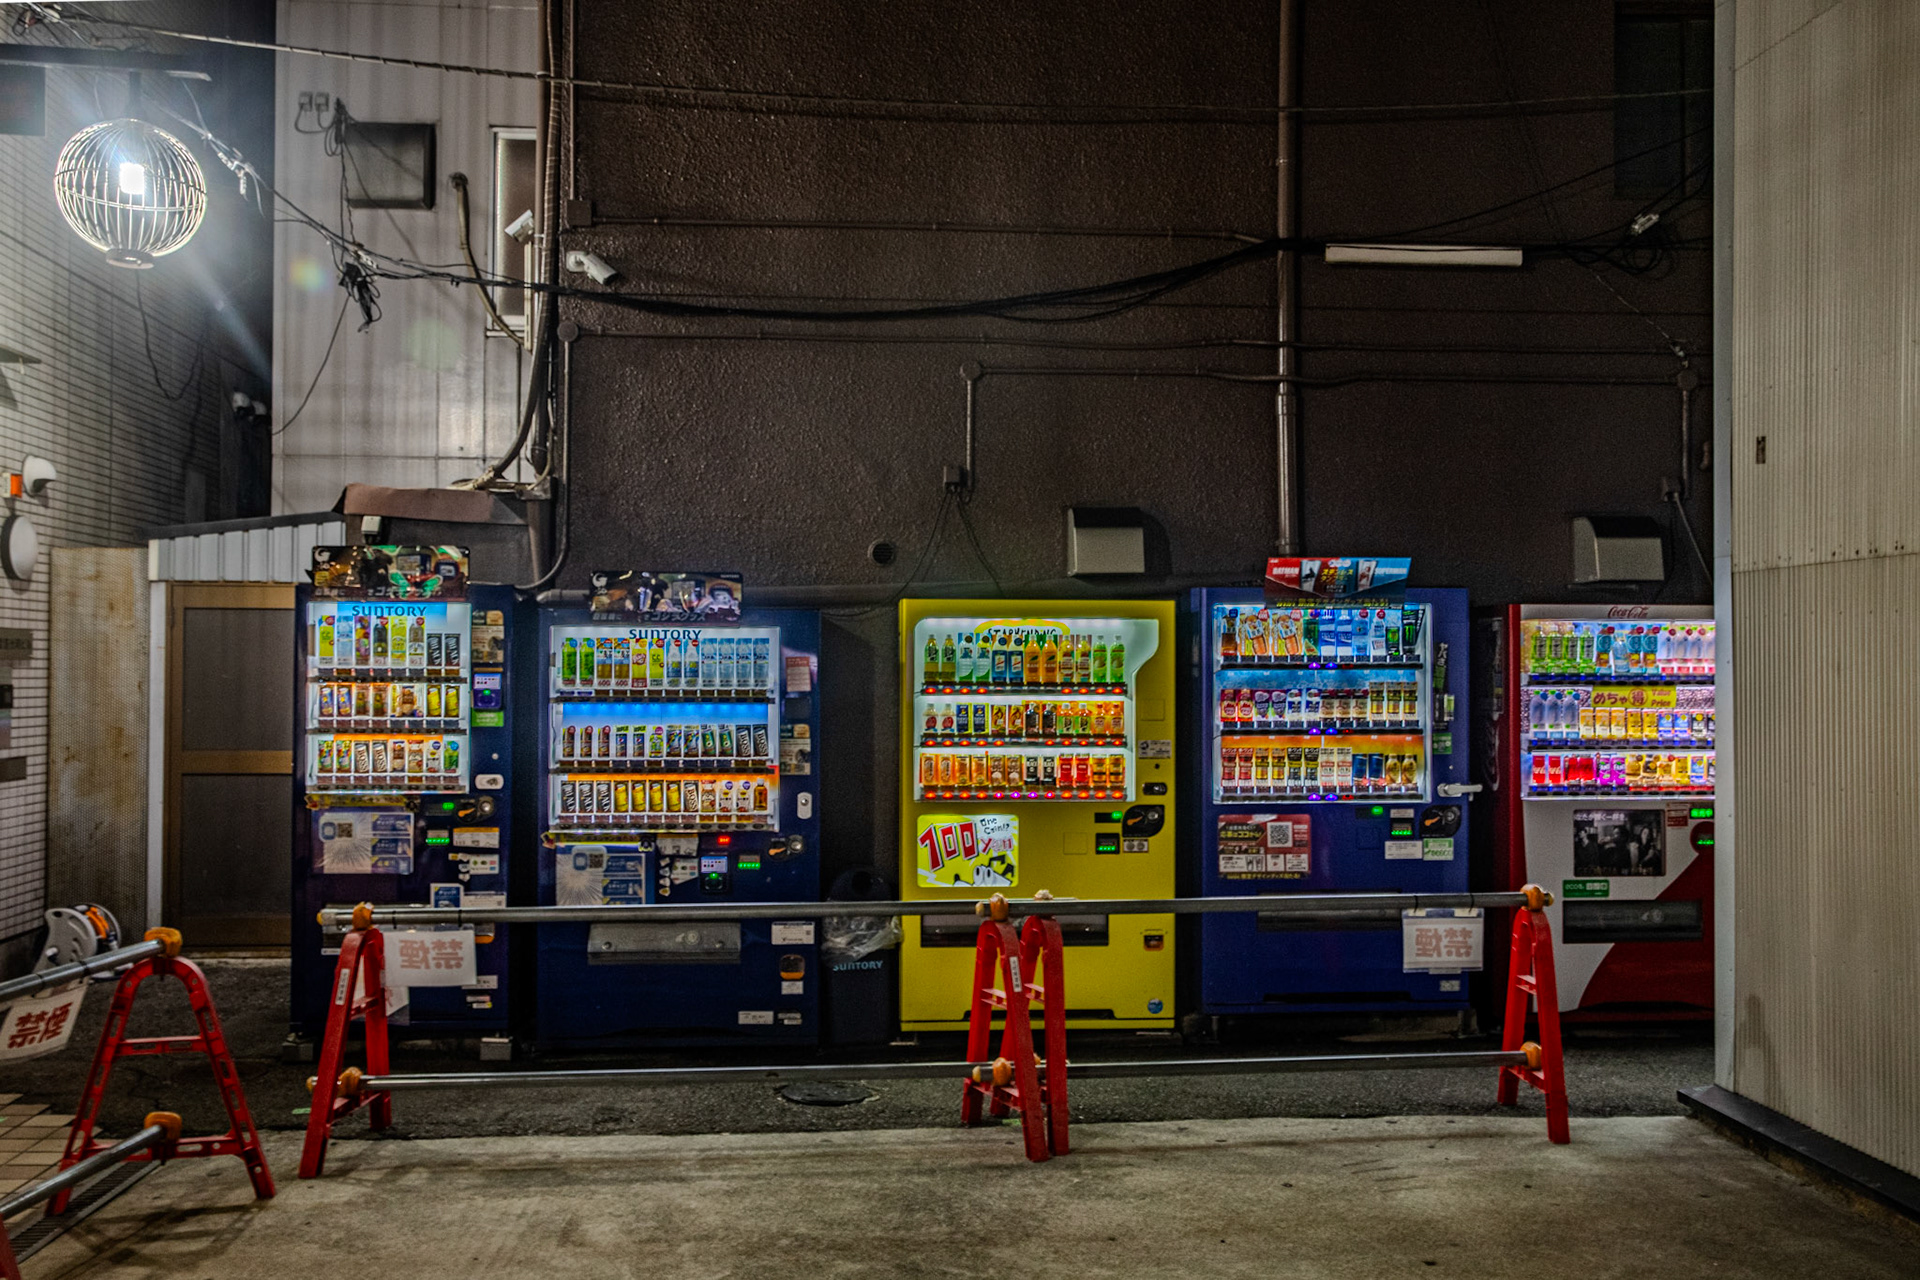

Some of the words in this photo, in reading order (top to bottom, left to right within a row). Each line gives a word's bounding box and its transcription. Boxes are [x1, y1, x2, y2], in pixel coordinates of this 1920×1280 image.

[352, 605, 427, 617] SUNTORY
[629, 629, 702, 640] SUNTORY
[980, 818, 998, 827] One
[918, 823, 979, 872] 100
[980, 838, 1014, 854] yen
[8, 1002, 73, 1049] 禁煙
